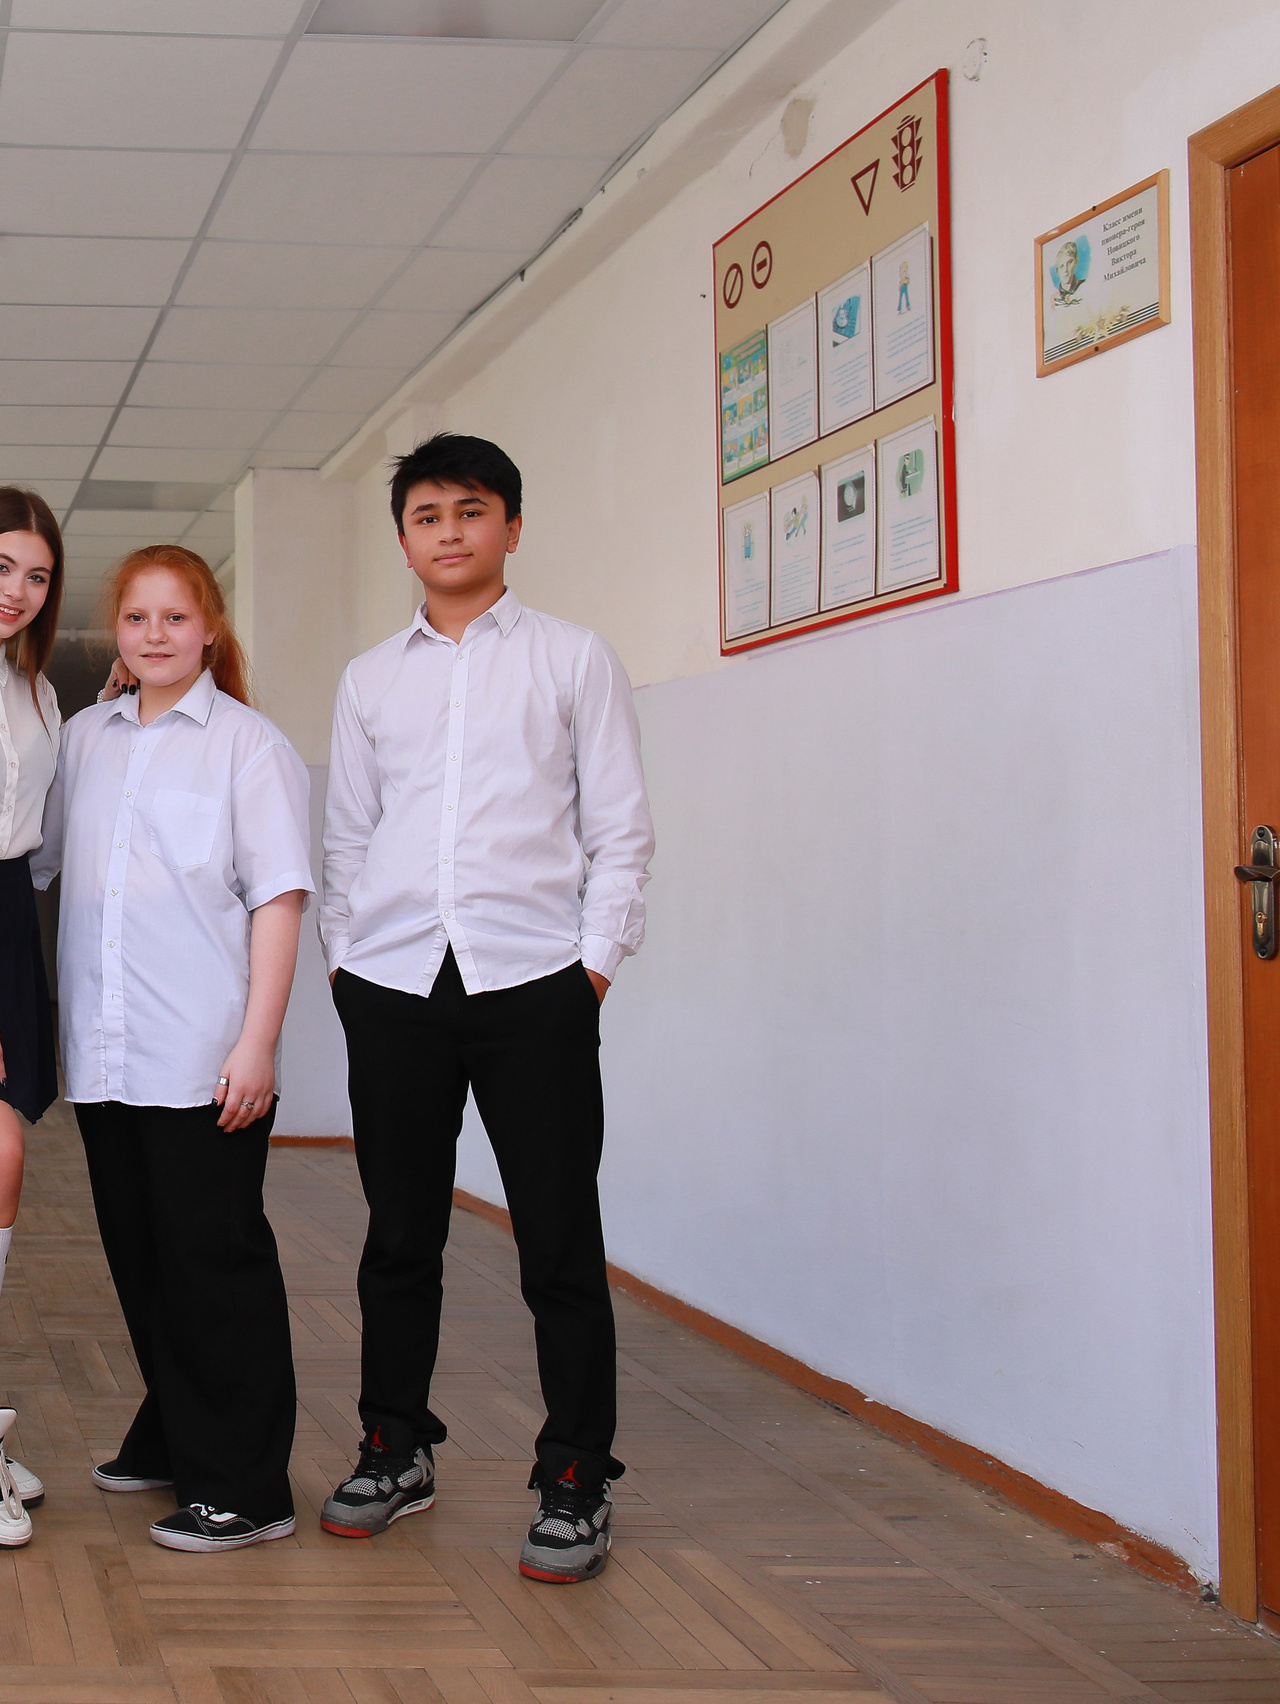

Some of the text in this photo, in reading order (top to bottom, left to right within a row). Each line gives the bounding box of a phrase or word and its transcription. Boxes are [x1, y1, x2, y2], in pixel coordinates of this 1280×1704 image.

[1103, 208, 1143, 232] Класс имени
[1101, 219, 1145, 246] пионера-героя
[1107, 234, 1140, 256] Новицкого
[1104, 257, 1146, 281] Михайловича
[1111, 249, 1137, 266] Виктора
